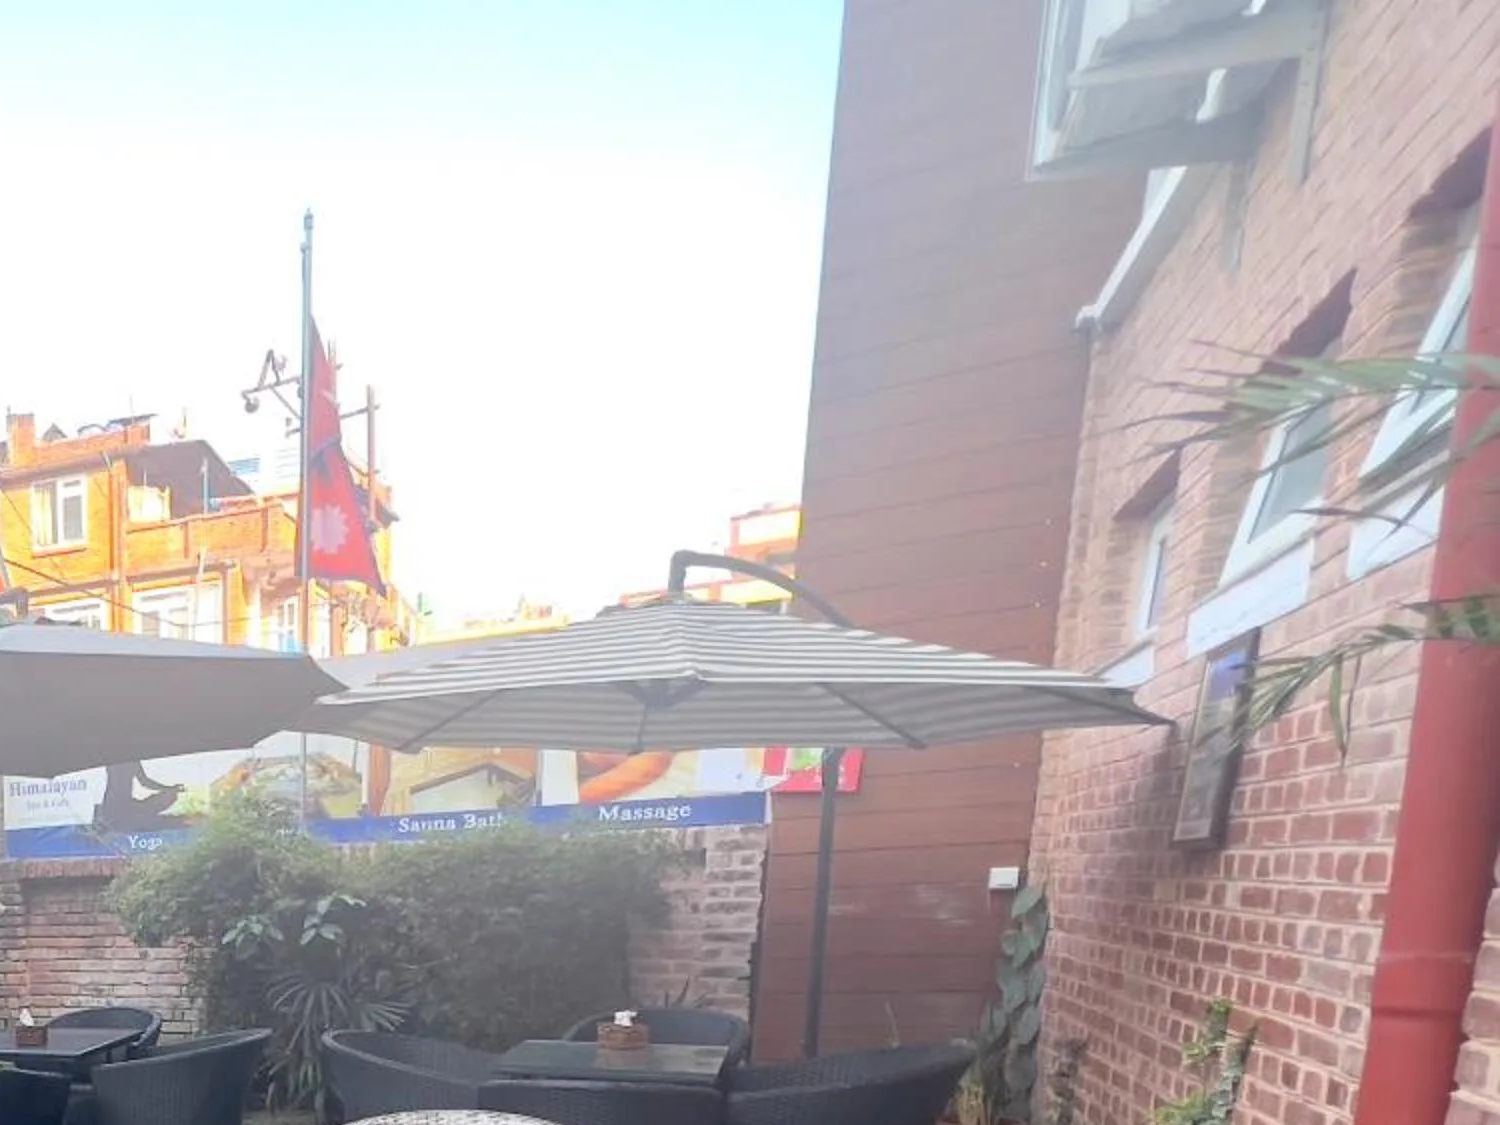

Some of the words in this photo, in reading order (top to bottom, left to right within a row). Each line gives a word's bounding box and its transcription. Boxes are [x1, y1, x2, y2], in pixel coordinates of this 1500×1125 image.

[9, 780, 87, 796] Himalayan
[599, 804, 692, 821] Massage
[128, 835, 162, 851] Yoga
